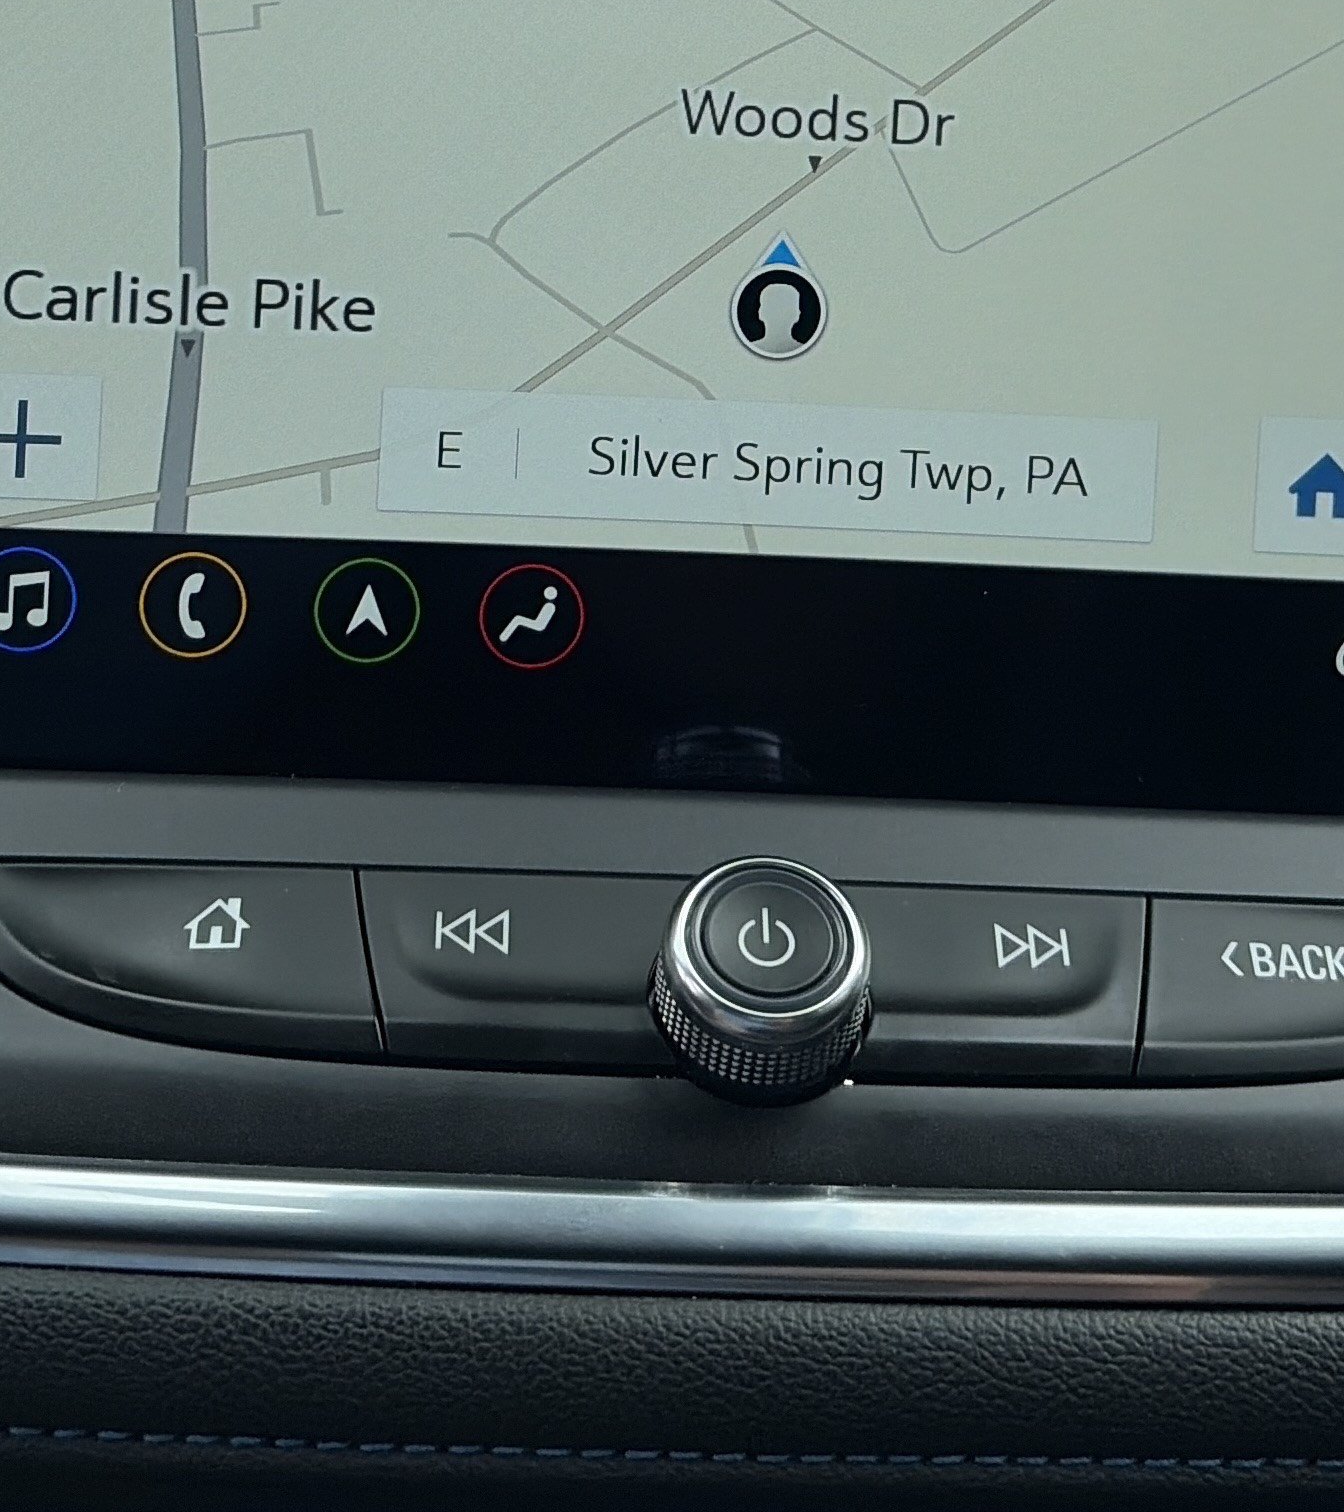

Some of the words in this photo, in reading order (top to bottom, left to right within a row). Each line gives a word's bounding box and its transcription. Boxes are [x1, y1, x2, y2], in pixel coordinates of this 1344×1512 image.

[681, 89, 869, 143] Woods
[892, 99, 955, 146] Dr
[3, 268, 229, 327] Carlisle
[253, 279, 376, 333] Pike
[438, 431, 462, 469] E
[588, 435, 718, 480] Silver
[734, 442, 884, 500] Spring
[900, 450, 1006, 504] Twp,
[1027, 456, 1088, 497] PA
